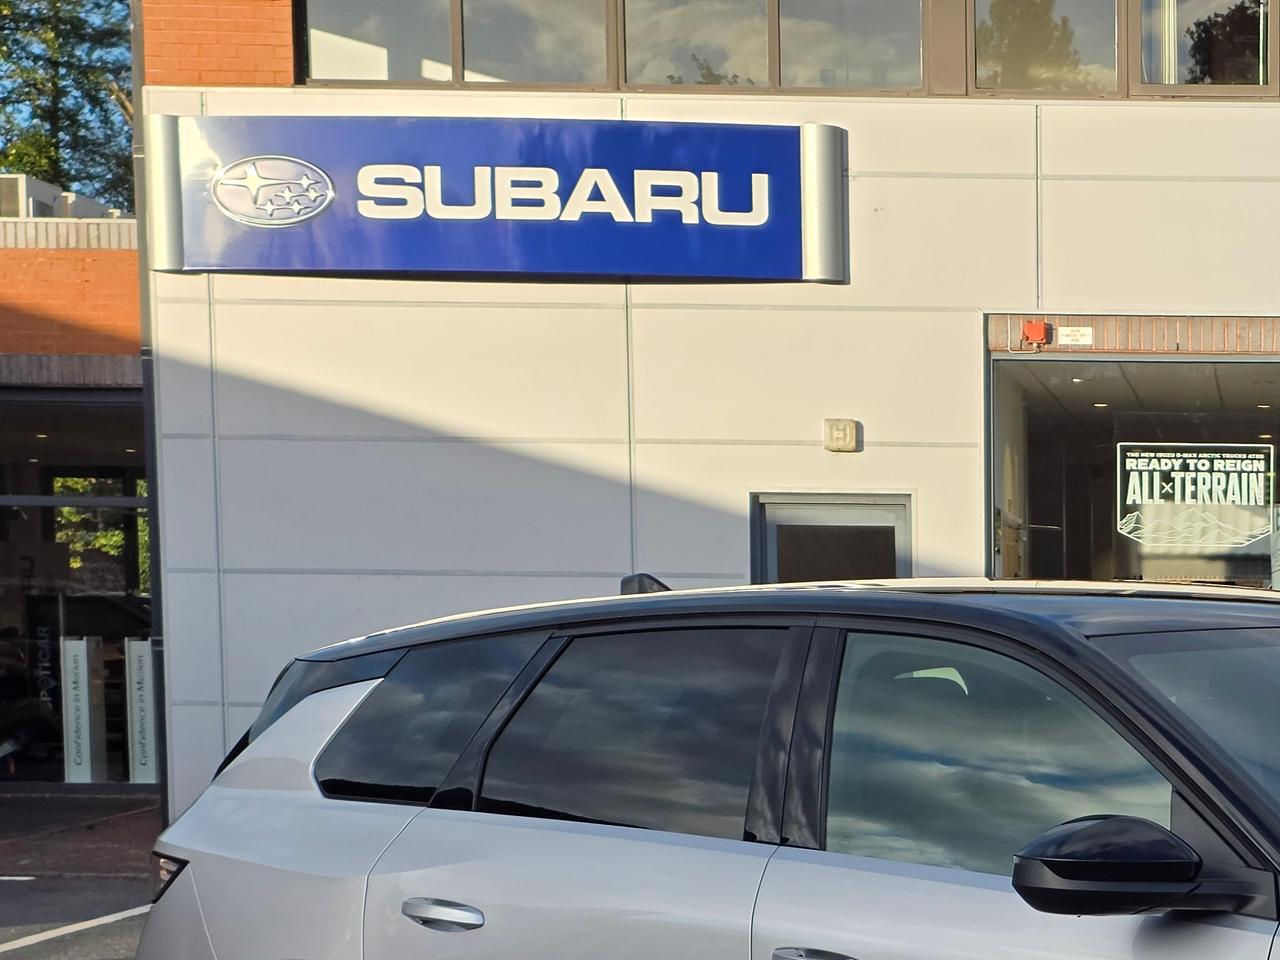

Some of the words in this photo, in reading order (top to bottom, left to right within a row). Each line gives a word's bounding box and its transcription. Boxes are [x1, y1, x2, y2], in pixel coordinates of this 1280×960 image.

[356, 163, 769, 226] SUBARU
[1126, 458, 1183, 470] READY
[1186, 459, 1210, 470] TO
[1213, 459, 1265, 471] REIGN
[1126, 471, 1165, 505] ALL
[1170, 471, 1264, 506] TERRAIN
[72, 654, 81, 691] Motion
[137, 655, 145, 691] Motion
[73, 704, 82, 766] Confidence
[139, 705, 148, 767] Confidence
